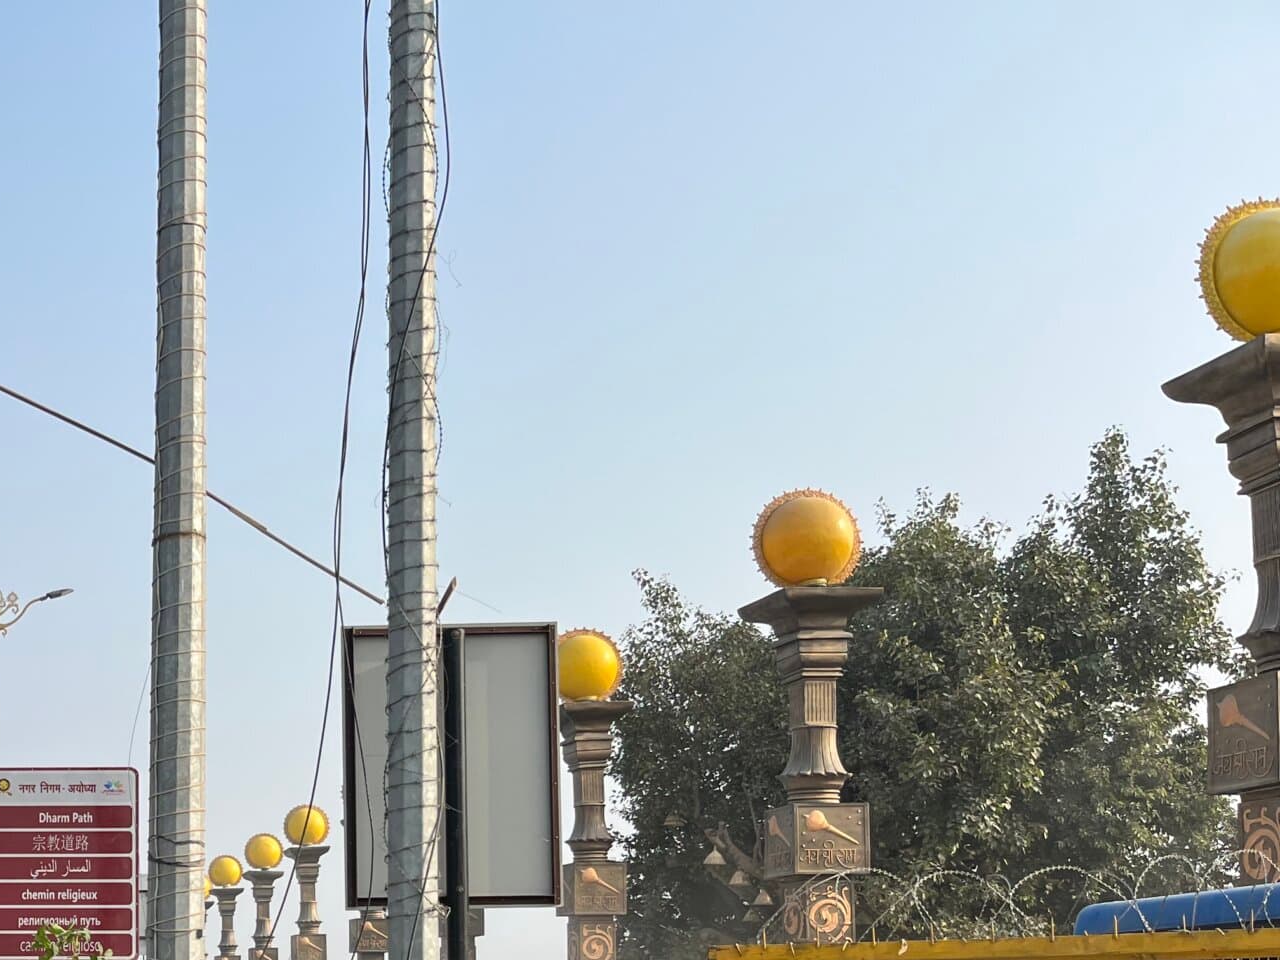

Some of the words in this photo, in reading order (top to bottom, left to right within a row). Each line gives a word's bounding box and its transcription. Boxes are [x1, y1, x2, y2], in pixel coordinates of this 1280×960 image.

[18, 784, 36, 793] नगर
[68, 781, 97, 793] अयोध्या
[38, 812, 70, 824] Dharm
[72, 812, 93, 824] Path
[32, 834, 89, 851] 宗教道路
[61, 859, 92, 877] المسار
[21, 889, 55, 900] chemin
[57, 889, 98, 903] religieux
[18, 915, 78, 928] религиозный
[80, 917, 102, 928] путь
